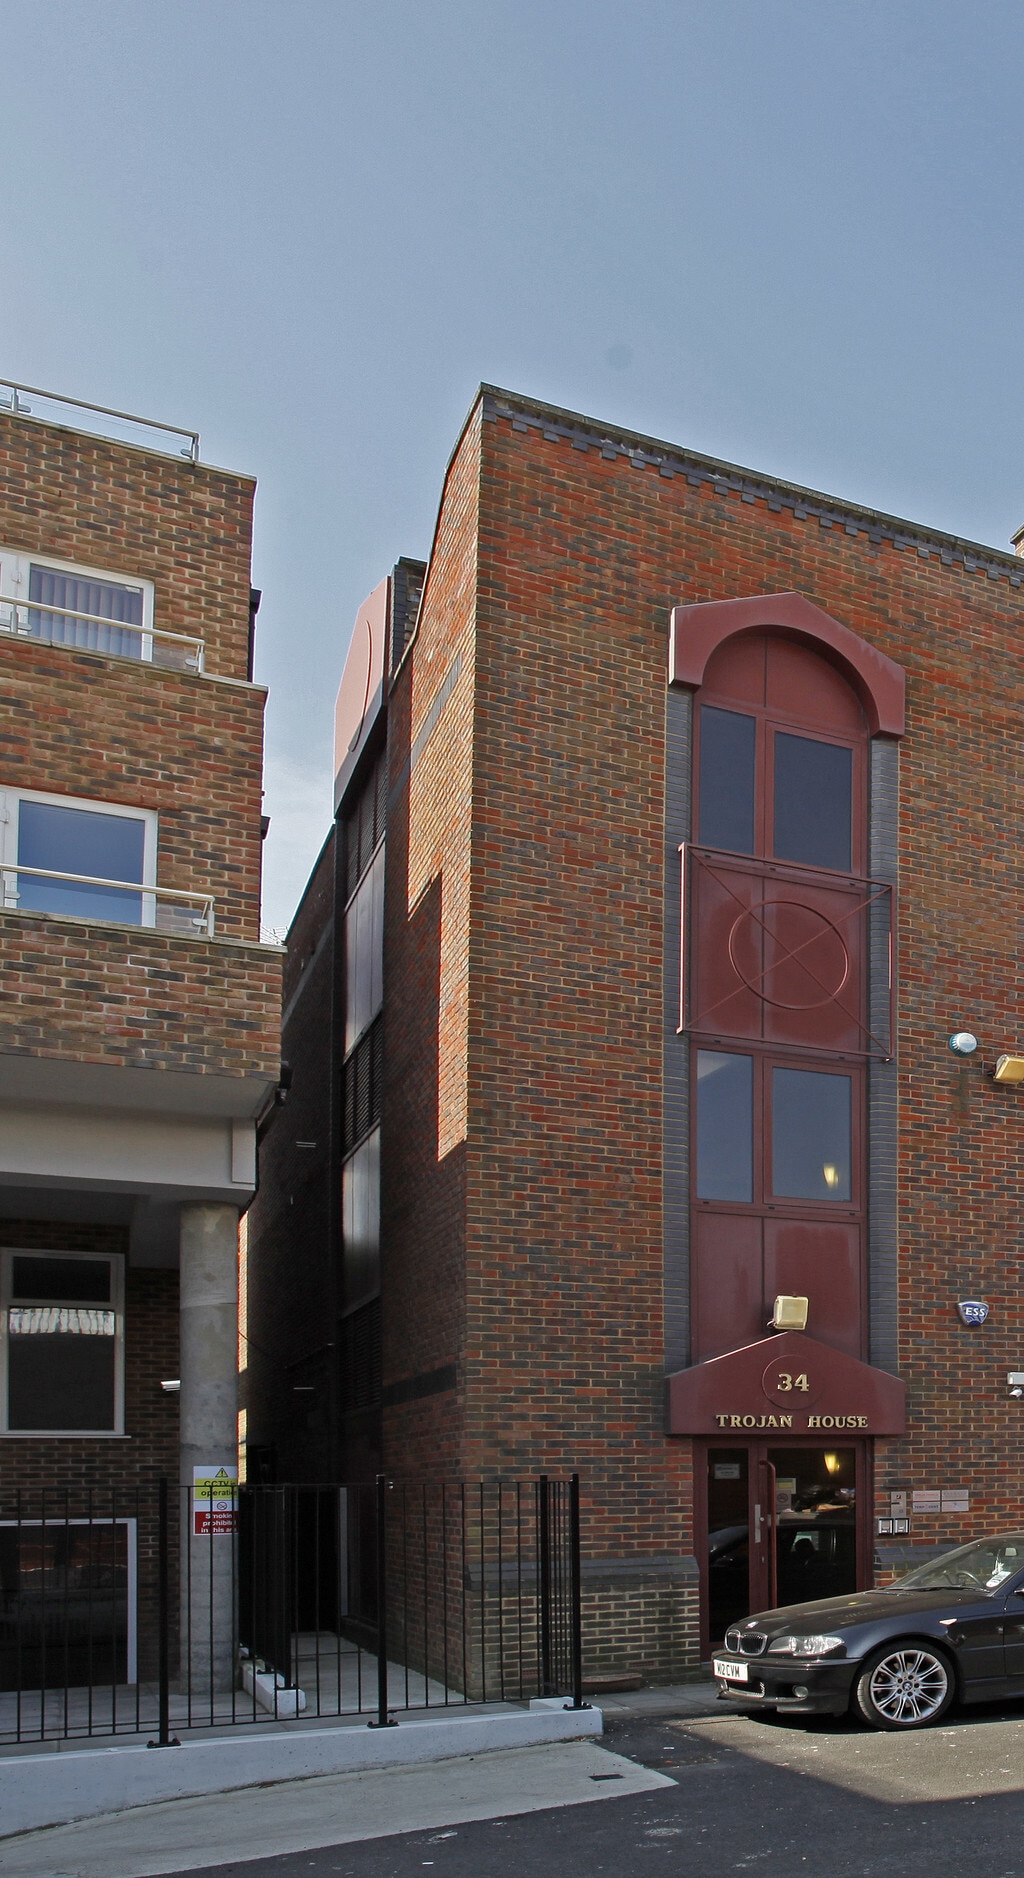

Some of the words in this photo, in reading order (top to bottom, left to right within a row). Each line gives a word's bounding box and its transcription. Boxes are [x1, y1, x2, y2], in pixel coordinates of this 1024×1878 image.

[965, 1307, 985, 1317] ESS
[777, 1373, 810, 1392] 34
[716, 1414, 793, 1428] TROJAN
[807, 1415, 868, 1428] HOUSE
